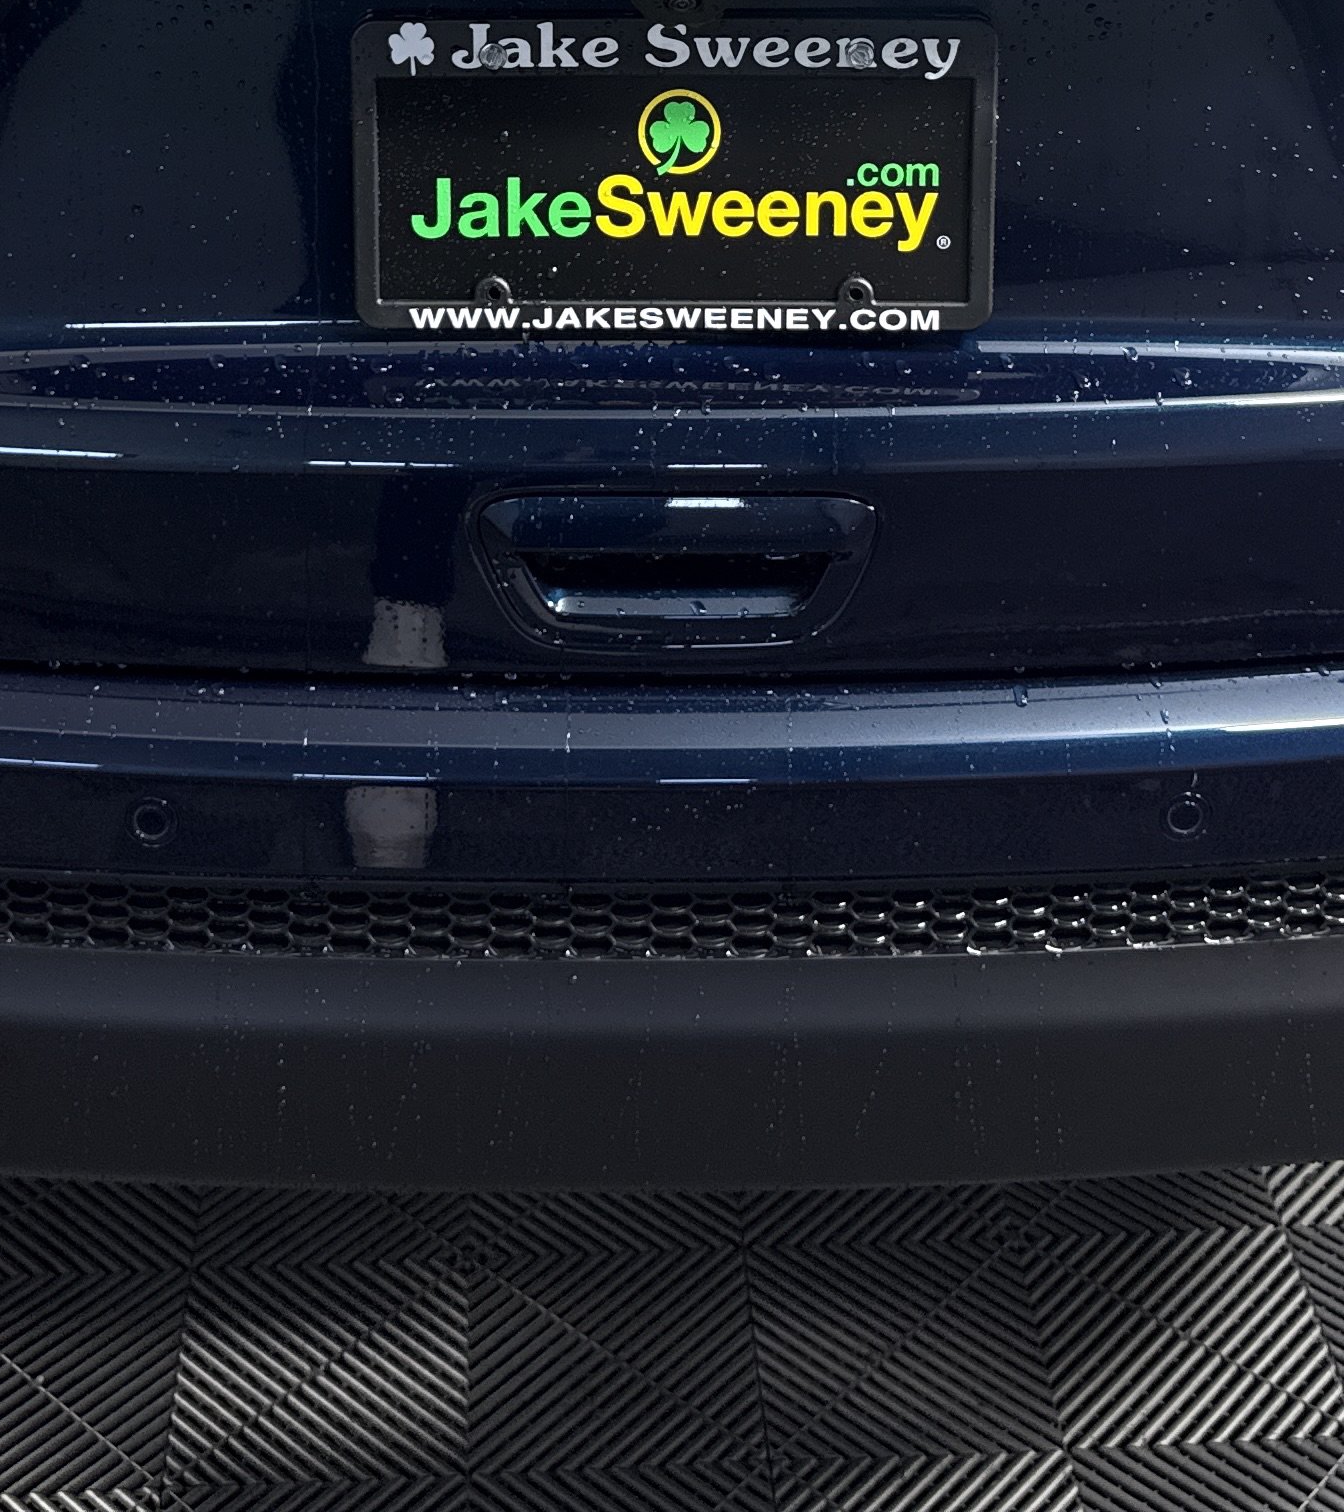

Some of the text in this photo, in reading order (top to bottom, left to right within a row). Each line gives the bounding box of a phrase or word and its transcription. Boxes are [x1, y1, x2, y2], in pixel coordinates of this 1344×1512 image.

[451, 21, 961, 80] Jake Sweeney
[408, 306, 941, 332] WWW.JAKESWEENEY.COM
